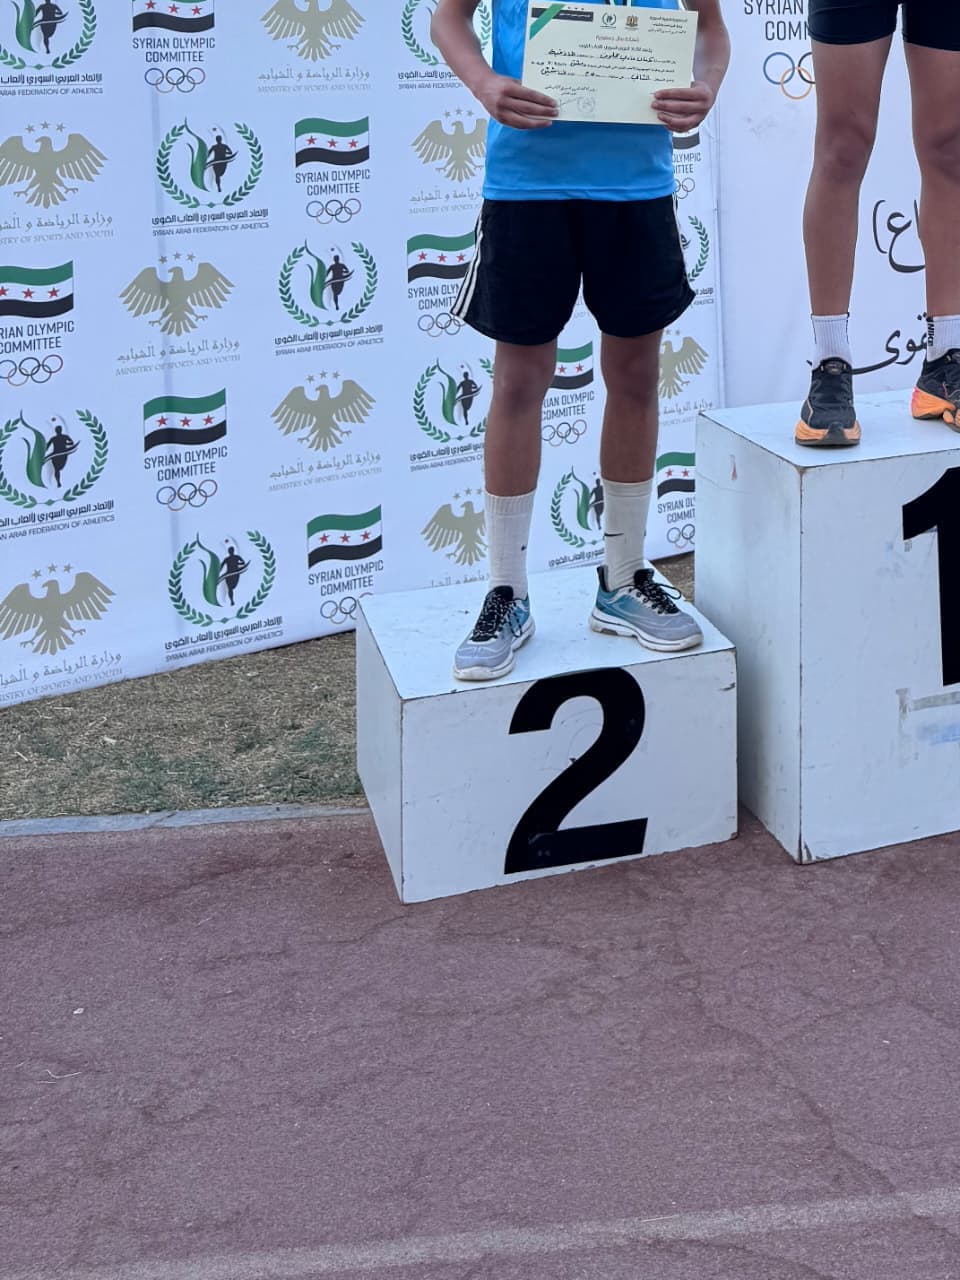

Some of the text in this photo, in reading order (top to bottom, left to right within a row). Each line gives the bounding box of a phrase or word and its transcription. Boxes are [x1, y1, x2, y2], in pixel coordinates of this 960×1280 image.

[132, 37, 216, 49] SYRIAN OLYMPIC
[145, 51, 204, 62] COMMITTEE
[295, 169, 371, 183] SYRIAN OLYMPIC
[306, 183, 360, 196] COMMITTEE
[408, 285, 439, 298] SYRIAN
[0, 320, 75, 339] RIAN OLYMPIC
[561, 391, 595, 405] OLYMPIC
[144, 446, 228, 470] SYRIAN OLYMPIC
[157, 461, 216, 482] COMMITTEE
[657, 499, 684, 514] SYRIAN
[308, 559, 384, 585] SYRIAN OLYMPIC
[320, 575, 374, 597] COMMITTEE
[504, 667, 648, 875] 2
